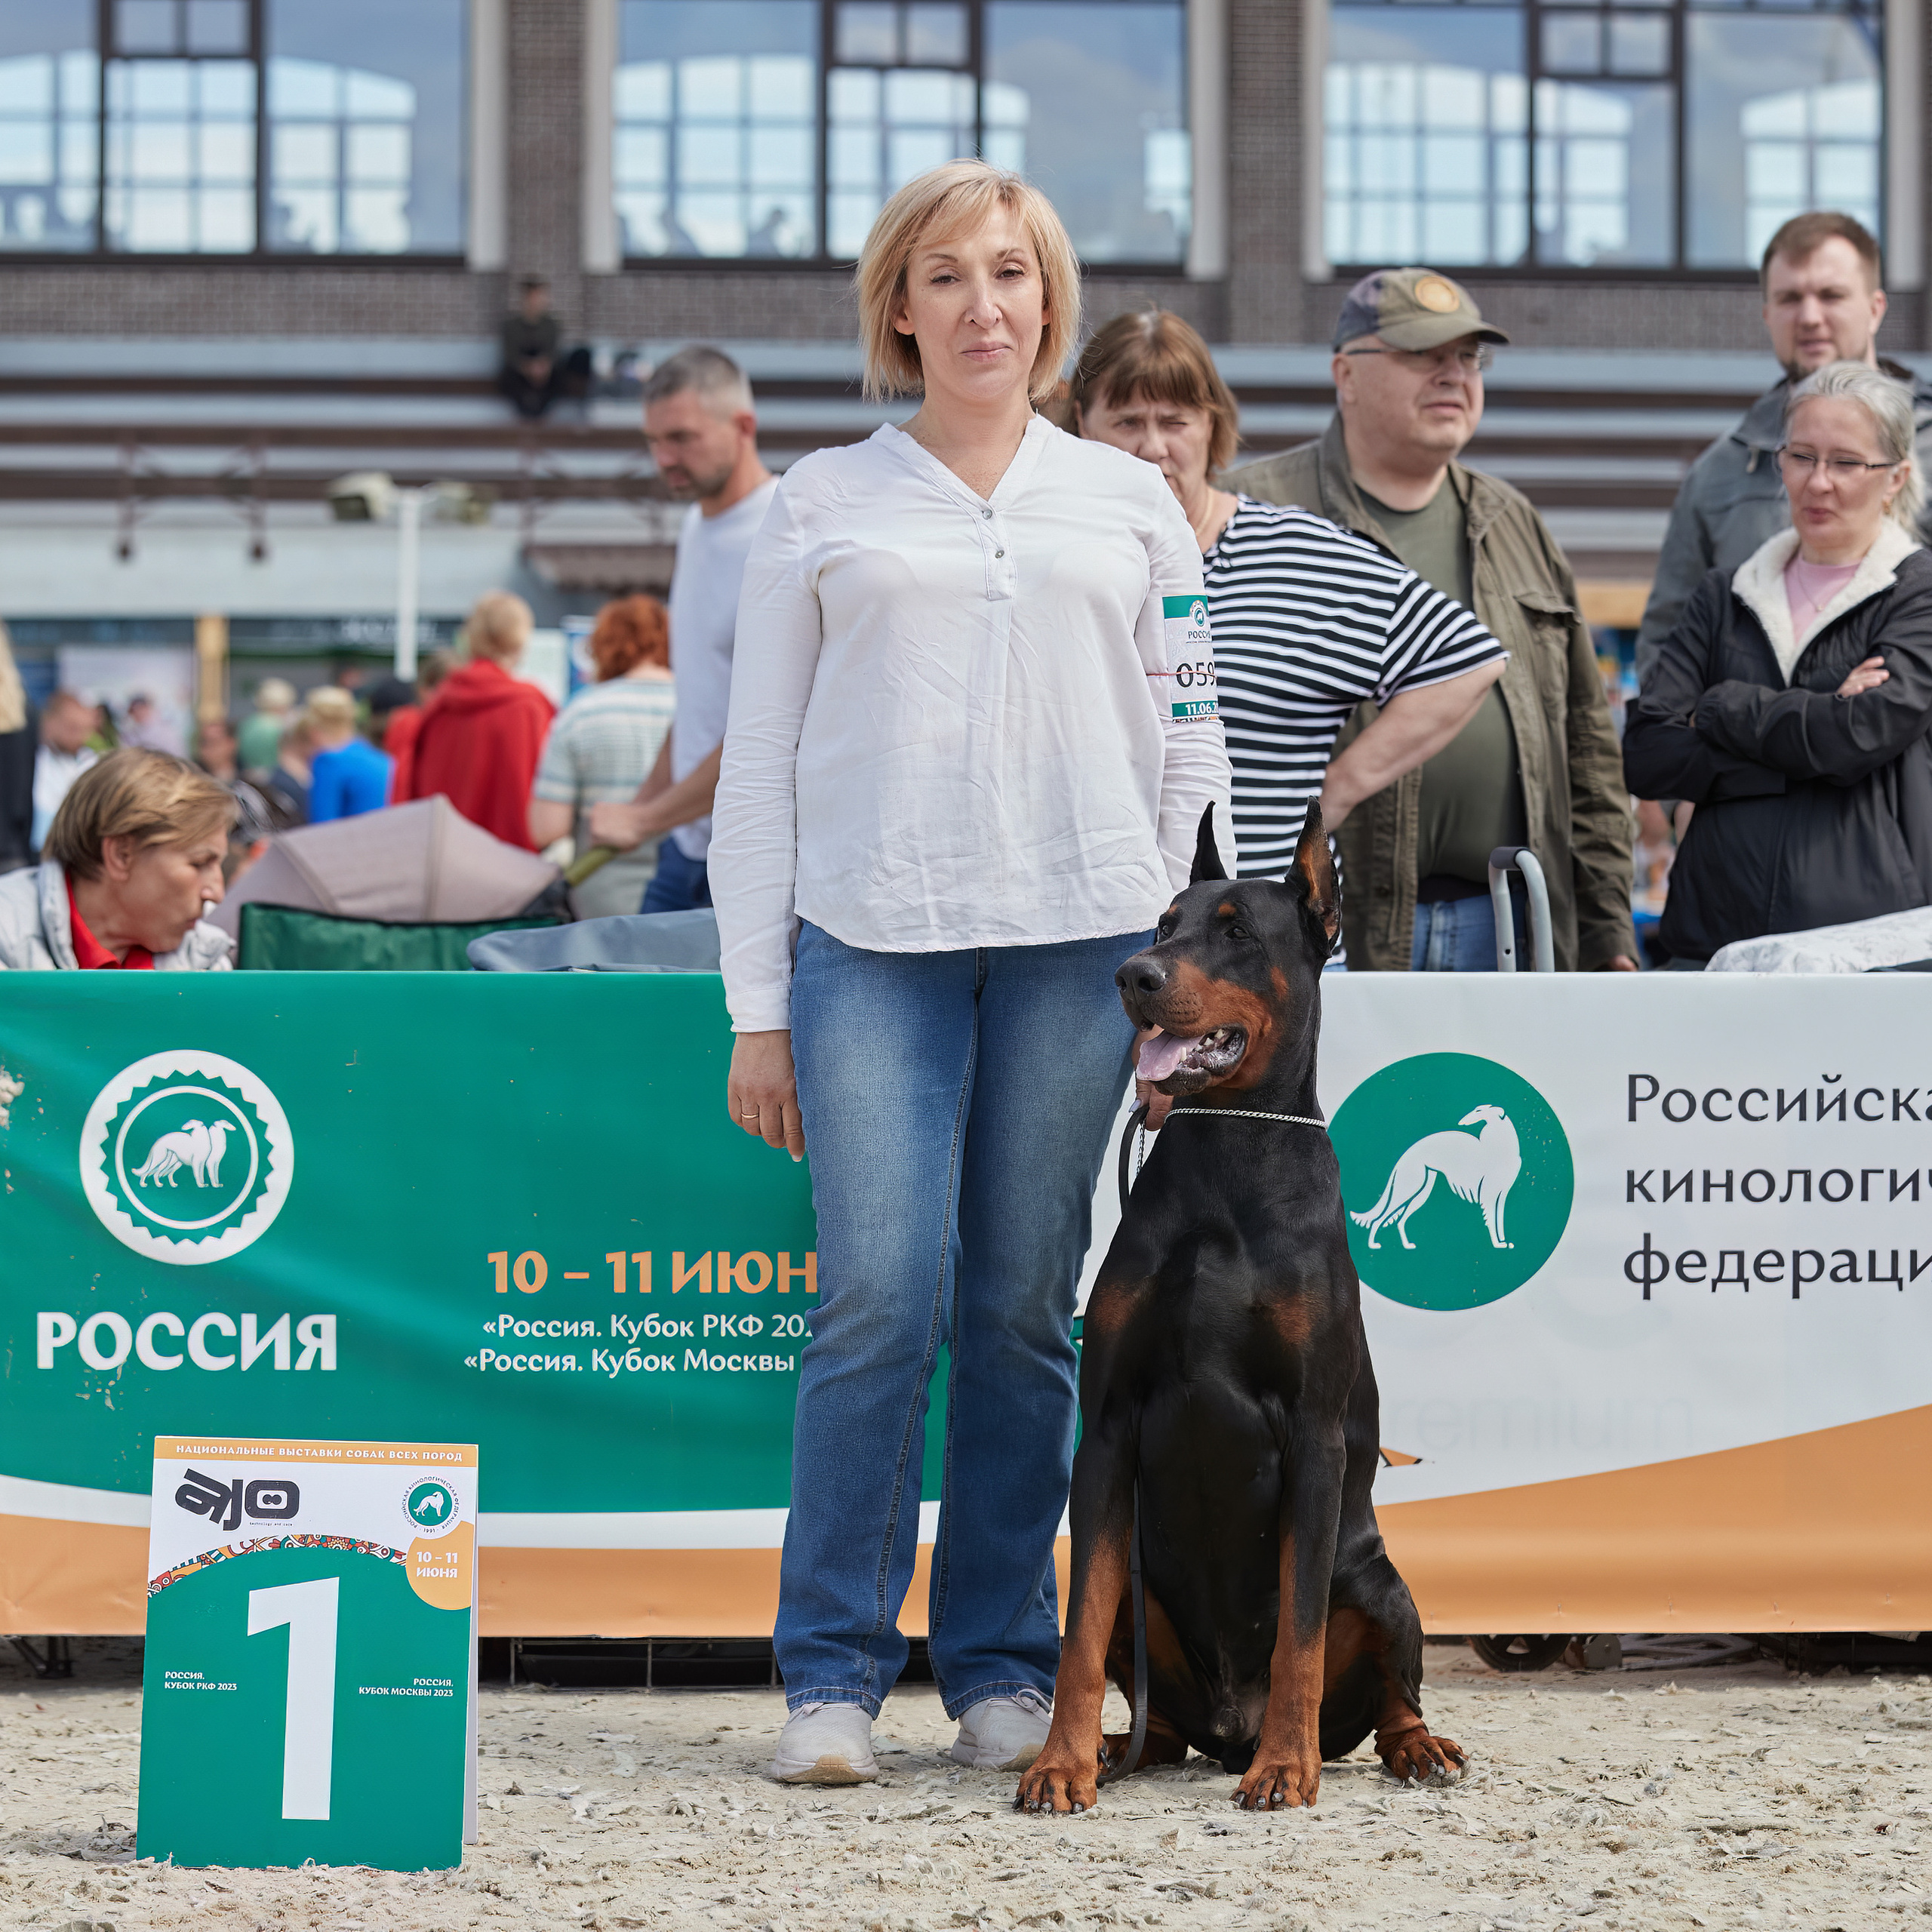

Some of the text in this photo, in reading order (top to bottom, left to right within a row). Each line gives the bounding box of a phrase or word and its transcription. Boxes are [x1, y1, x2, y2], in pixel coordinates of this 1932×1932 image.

[1627, 1073, 1932, 1124] Российск
[1626, 1168, 1932, 1204] кинологи
[487, 1250, 548, 1294] 10
[605, 1251, 652, 1294] 11
[482, 1314, 602, 1338] «Россия.
[611, 1312, 694, 1344] Кубок
[703, 1314, 764, 1338] РКФ
[36, 1311, 337, 1372] РОССИЯ
[464, 1347, 794, 1379] «Россия. Кубок Москвы
[176, 1444, 463, 1463] НАЦИОНАЛЬНЫЕ ВЫСТАВКИ СОБАК ВСЕХ ПОРОД
[416, 1551, 432, 1563] 10
[445, 1552, 458, 1564] 11
[416, 1567, 458, 1579] ИЮНЯ
[164, 1681, 238, 1690] КУБОК РКФ 2023
[165, 1671, 205, 1680] РОССИЯ.
[413, 1678, 454, 1687] РОССИЯ.
[247, 1576, 340, 1821] 1
[358, 1687, 454, 1697] КУБОК МОСКВЫ 2023
